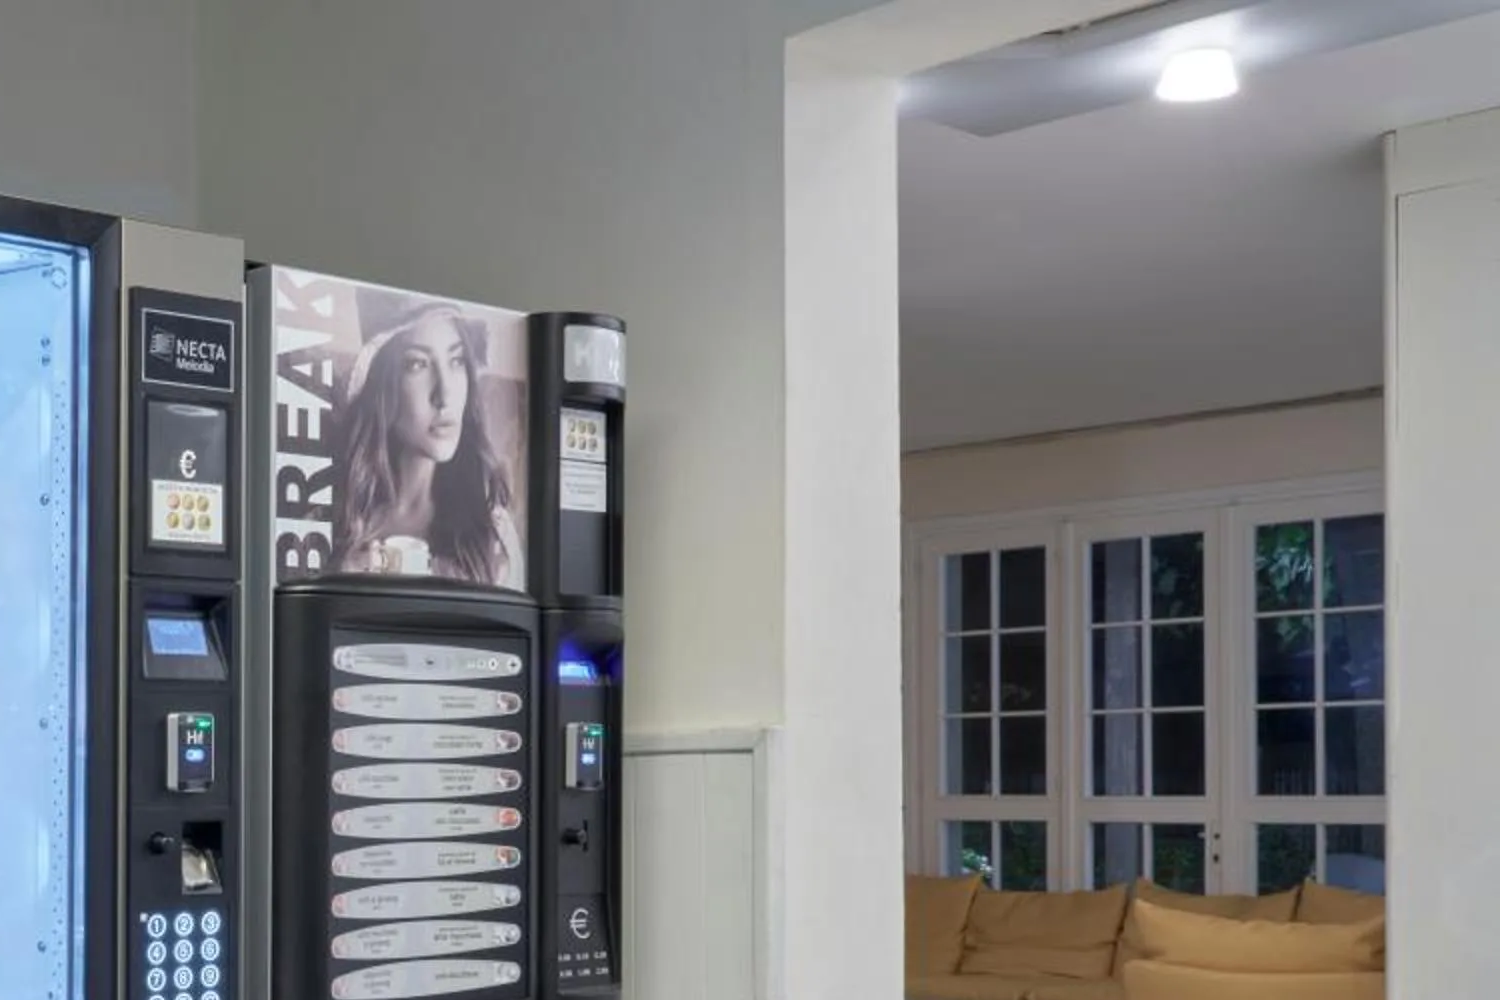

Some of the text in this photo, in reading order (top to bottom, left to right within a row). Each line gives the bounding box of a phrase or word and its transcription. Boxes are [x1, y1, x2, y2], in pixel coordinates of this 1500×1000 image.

[176, 337, 227, 362] NECTA
[175, 357, 215, 374] Melodia
[275, 268, 334, 582] BREAK
[179, 449, 198, 479] €
[569, 906, 591, 939] €
